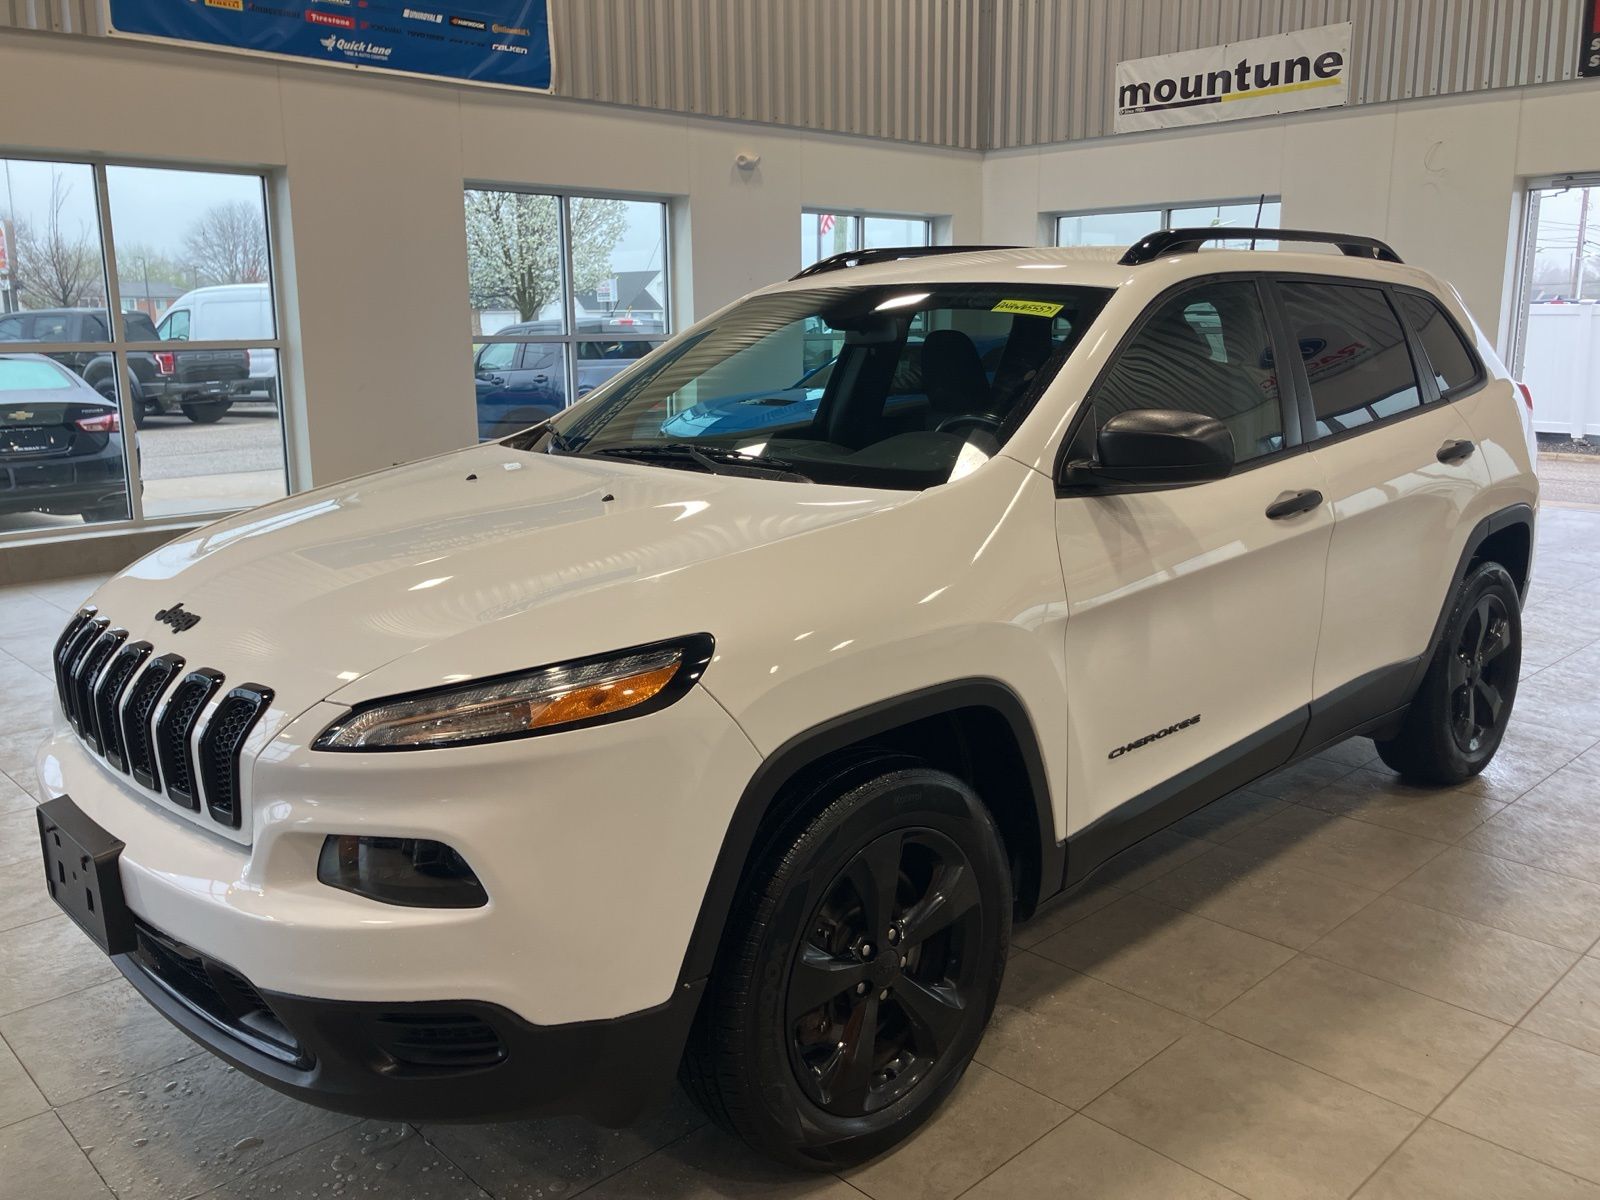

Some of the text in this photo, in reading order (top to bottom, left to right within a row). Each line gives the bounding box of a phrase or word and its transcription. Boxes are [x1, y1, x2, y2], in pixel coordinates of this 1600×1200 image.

[311, 13, 350, 26] Firestone
[336, 38, 392, 56] Quick Lane
[492, 43, 528, 54] FALKEN
[1119, 51, 1343, 108] mountune
[155, 602, 201, 634] Jeep
[1108, 714, 1201, 759] CHEROKEE
